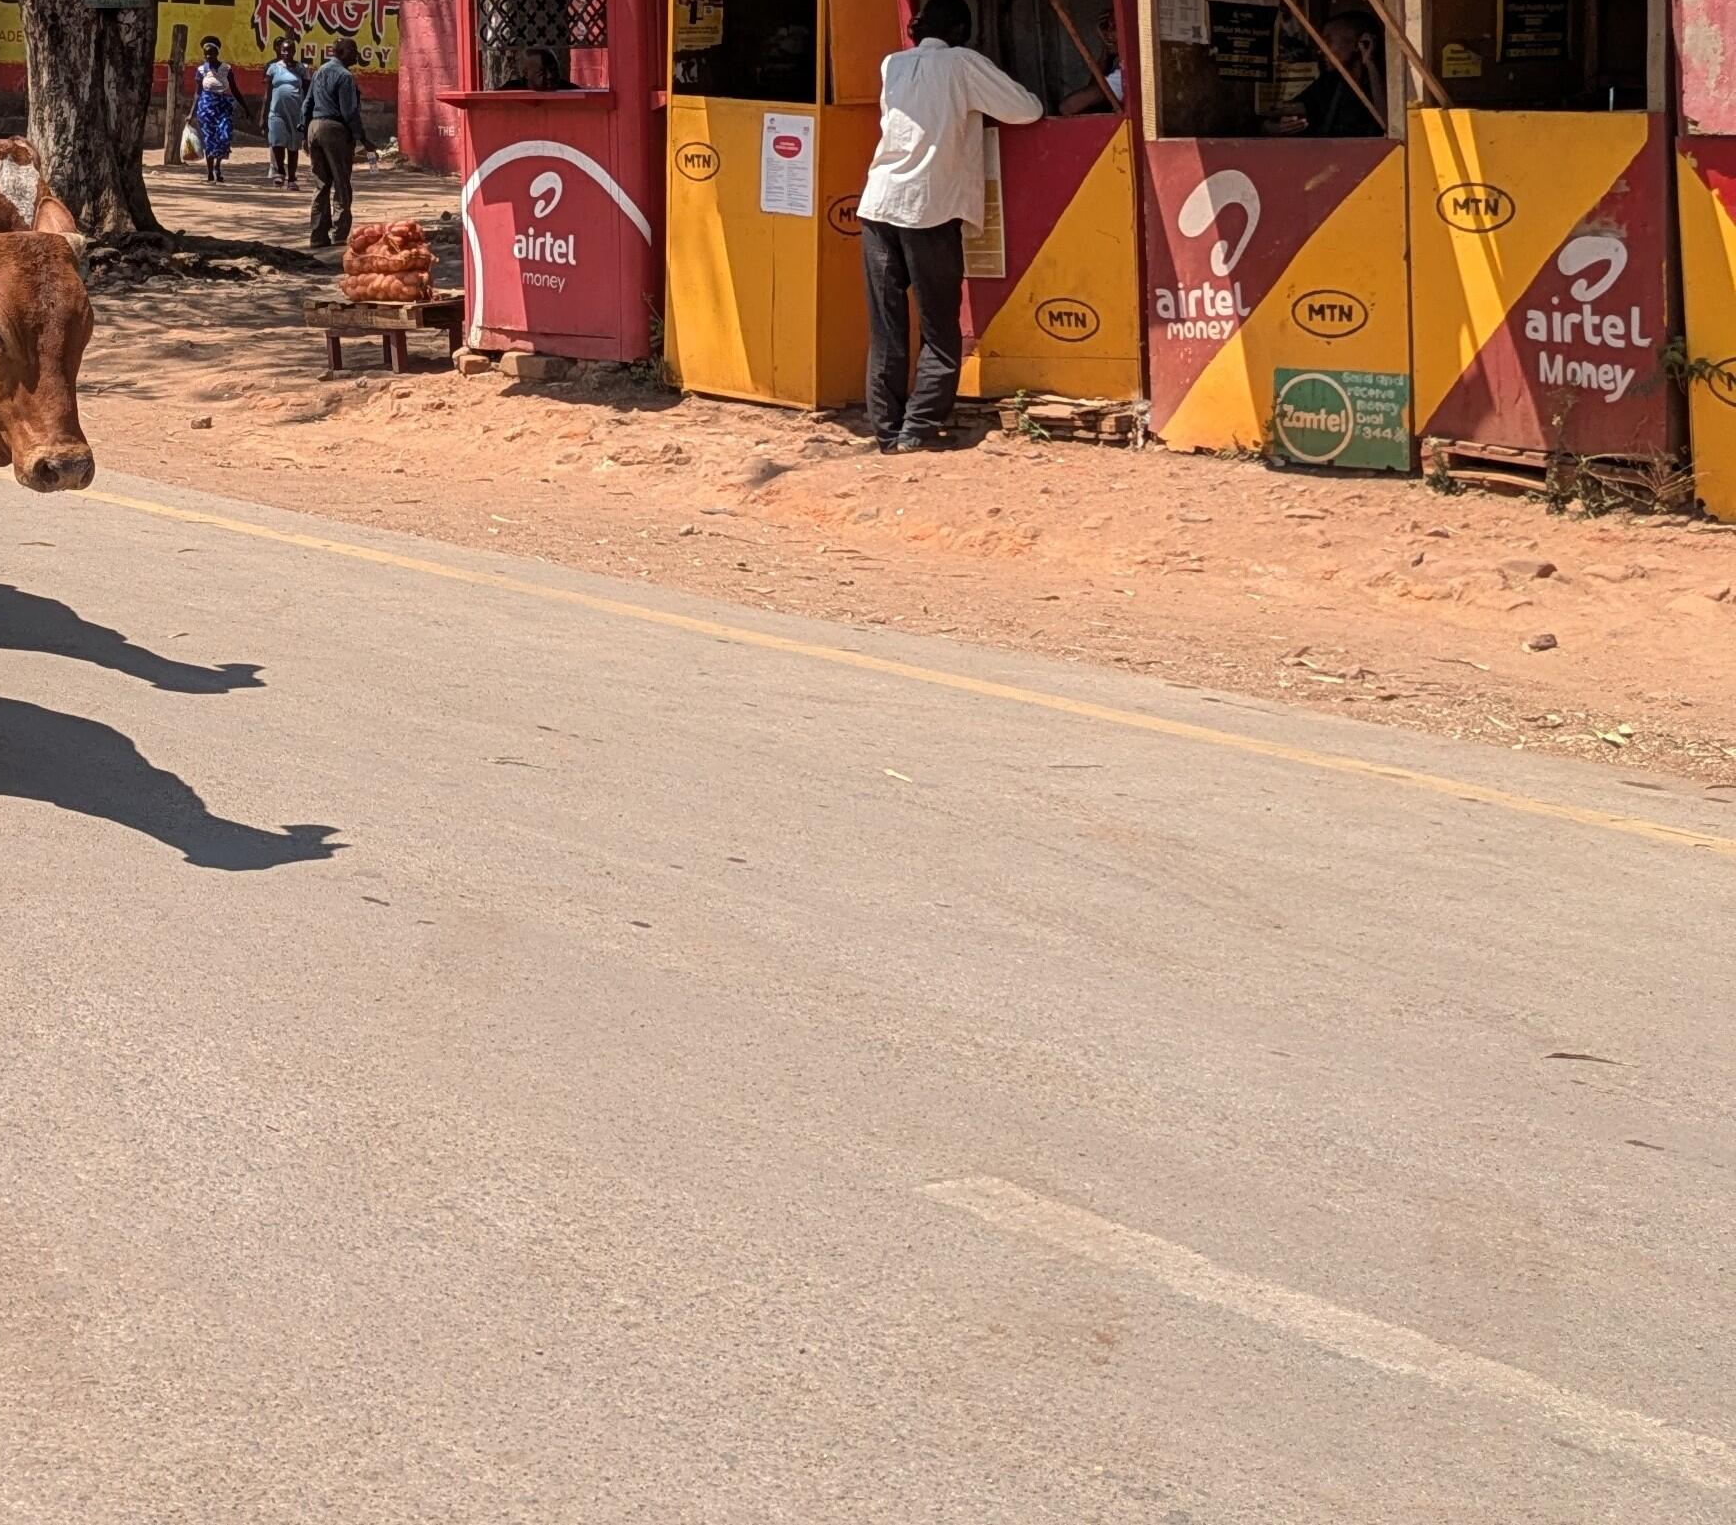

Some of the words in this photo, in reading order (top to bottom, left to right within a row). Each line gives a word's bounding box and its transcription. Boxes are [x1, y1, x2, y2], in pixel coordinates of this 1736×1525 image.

[684, 154, 711, 169] MTN
[1451, 197, 1499, 217] MTN
[513, 226, 576, 266] airtel
[522, 272, 565, 294] money
[1155, 281, 1251, 319] airtel
[1047, 309, 1087, 329] MTN
[1307, 304, 1353, 323] MTN
[1525, 296, 1652, 348] airtel
[1167, 320, 1234, 341] money
[1539, 351, 1636, 403] Money
[1282, 404, 1346, 433] Zamtel
